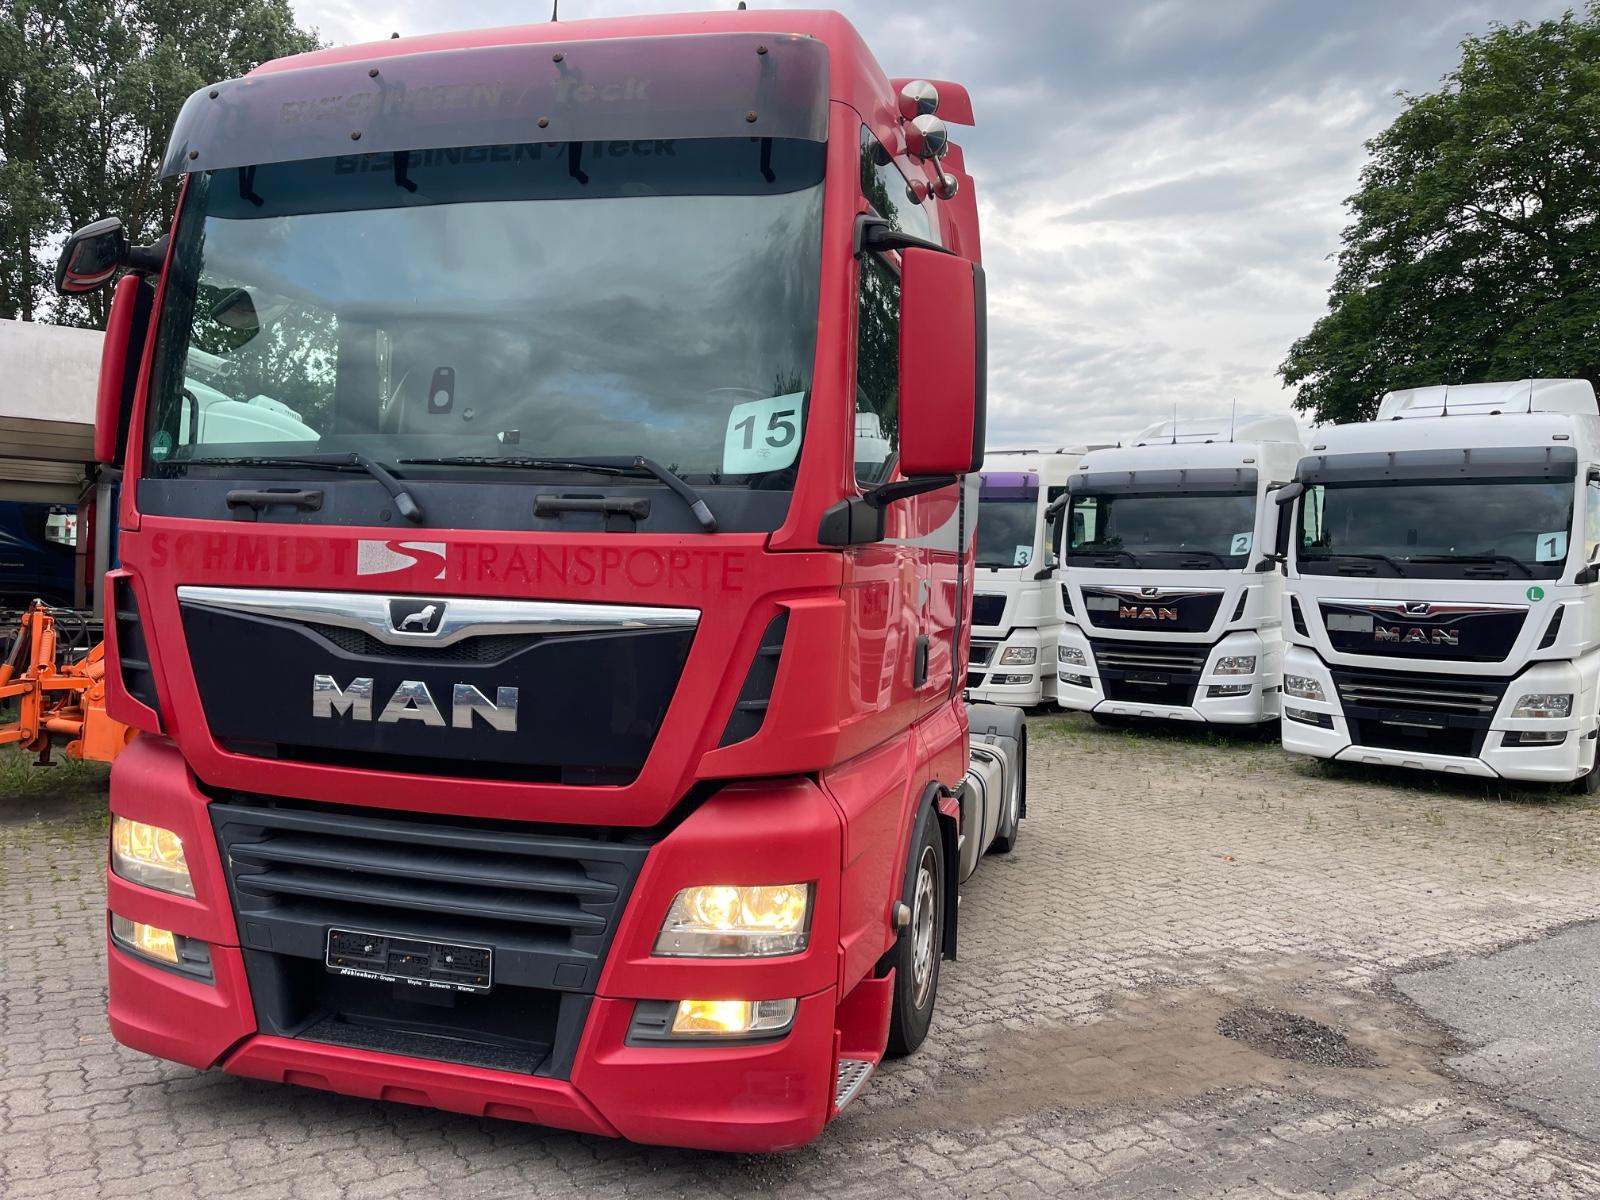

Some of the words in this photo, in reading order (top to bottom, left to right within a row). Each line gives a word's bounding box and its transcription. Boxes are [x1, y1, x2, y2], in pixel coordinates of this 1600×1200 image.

[550, 76, 652, 104] Teck
[734, 409, 796, 449] 15
[1234, 537, 1248, 553] 2
[1543, 537, 1558, 559] 1
[150, 532, 349, 576] SCHMIDT
[453, 542, 745, 592] TRANSPORTE
[1017, 551, 1028, 566] 3
[1119, 606, 1178, 621] MAN
[1374, 626, 1459, 646] MAN
[312, 674, 519, 732] MAN
